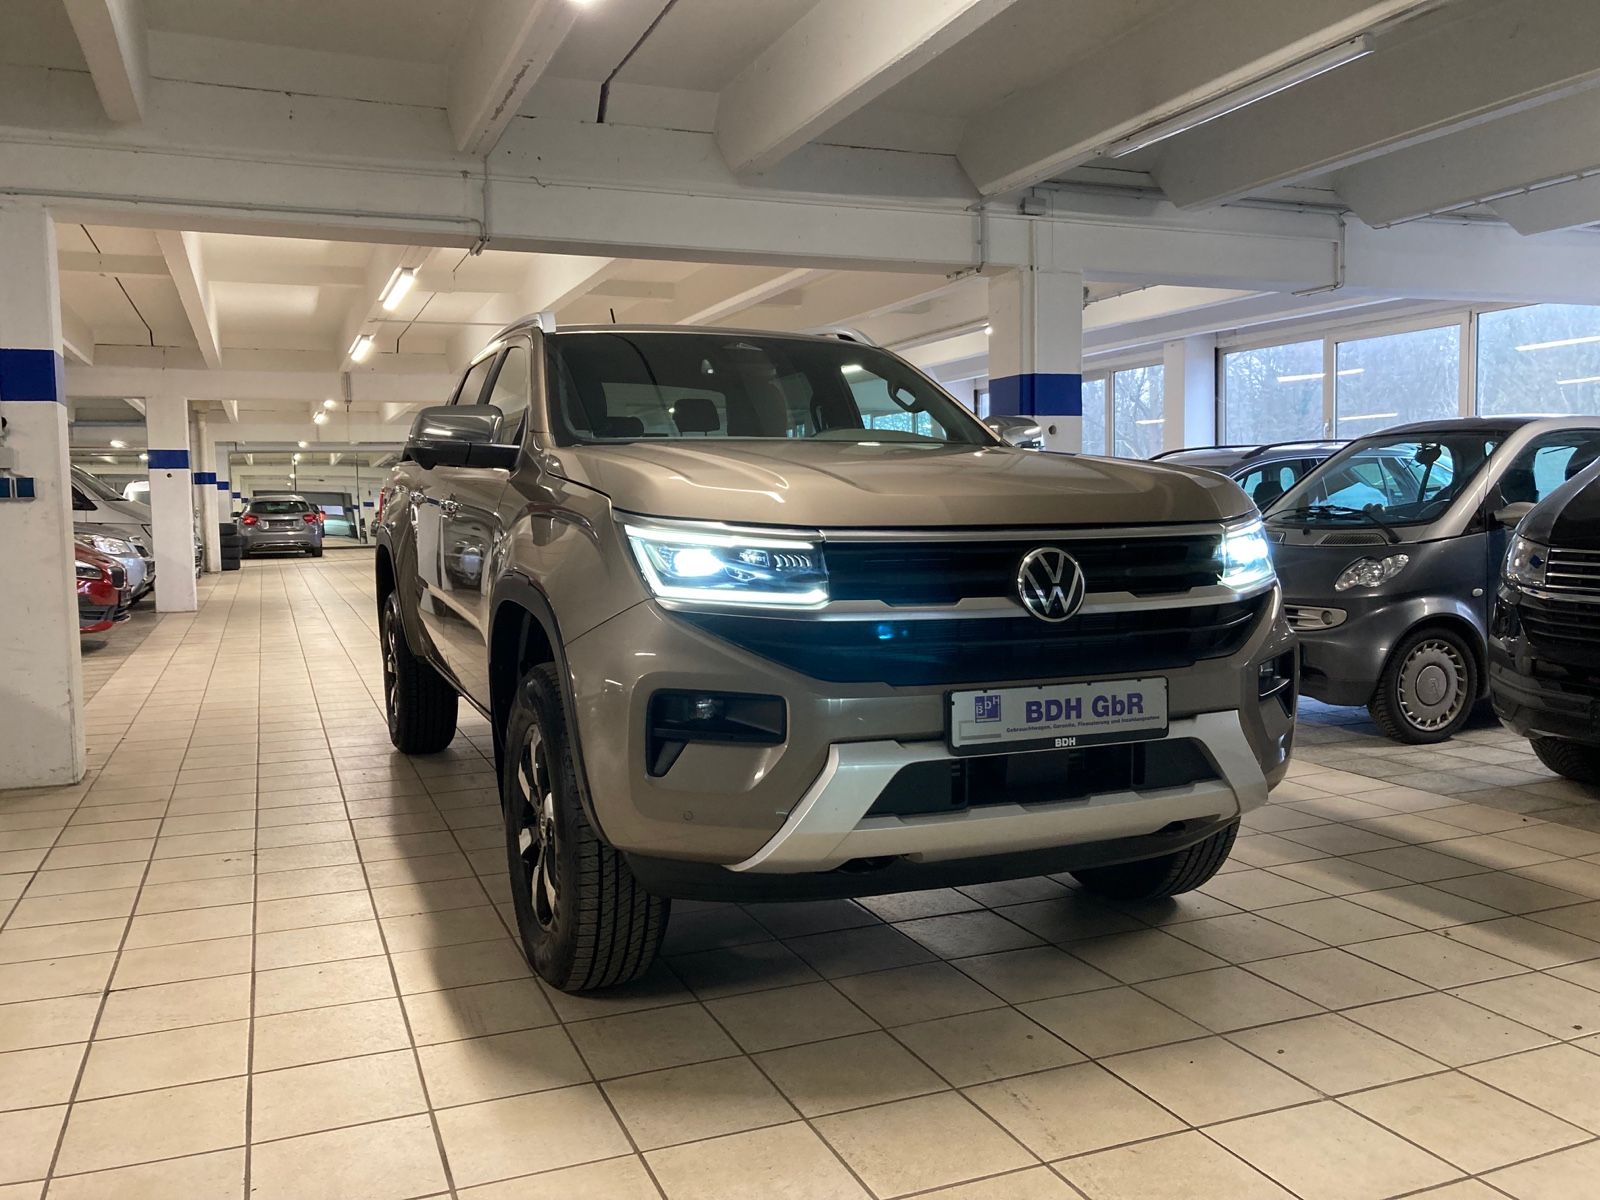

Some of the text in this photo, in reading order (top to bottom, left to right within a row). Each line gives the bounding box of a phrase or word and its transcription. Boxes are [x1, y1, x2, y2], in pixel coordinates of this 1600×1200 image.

[1022, 550, 1081, 616] VW
[1025, 692, 1144, 723] BDH GbR
[1055, 737, 1076, 747] BDH
